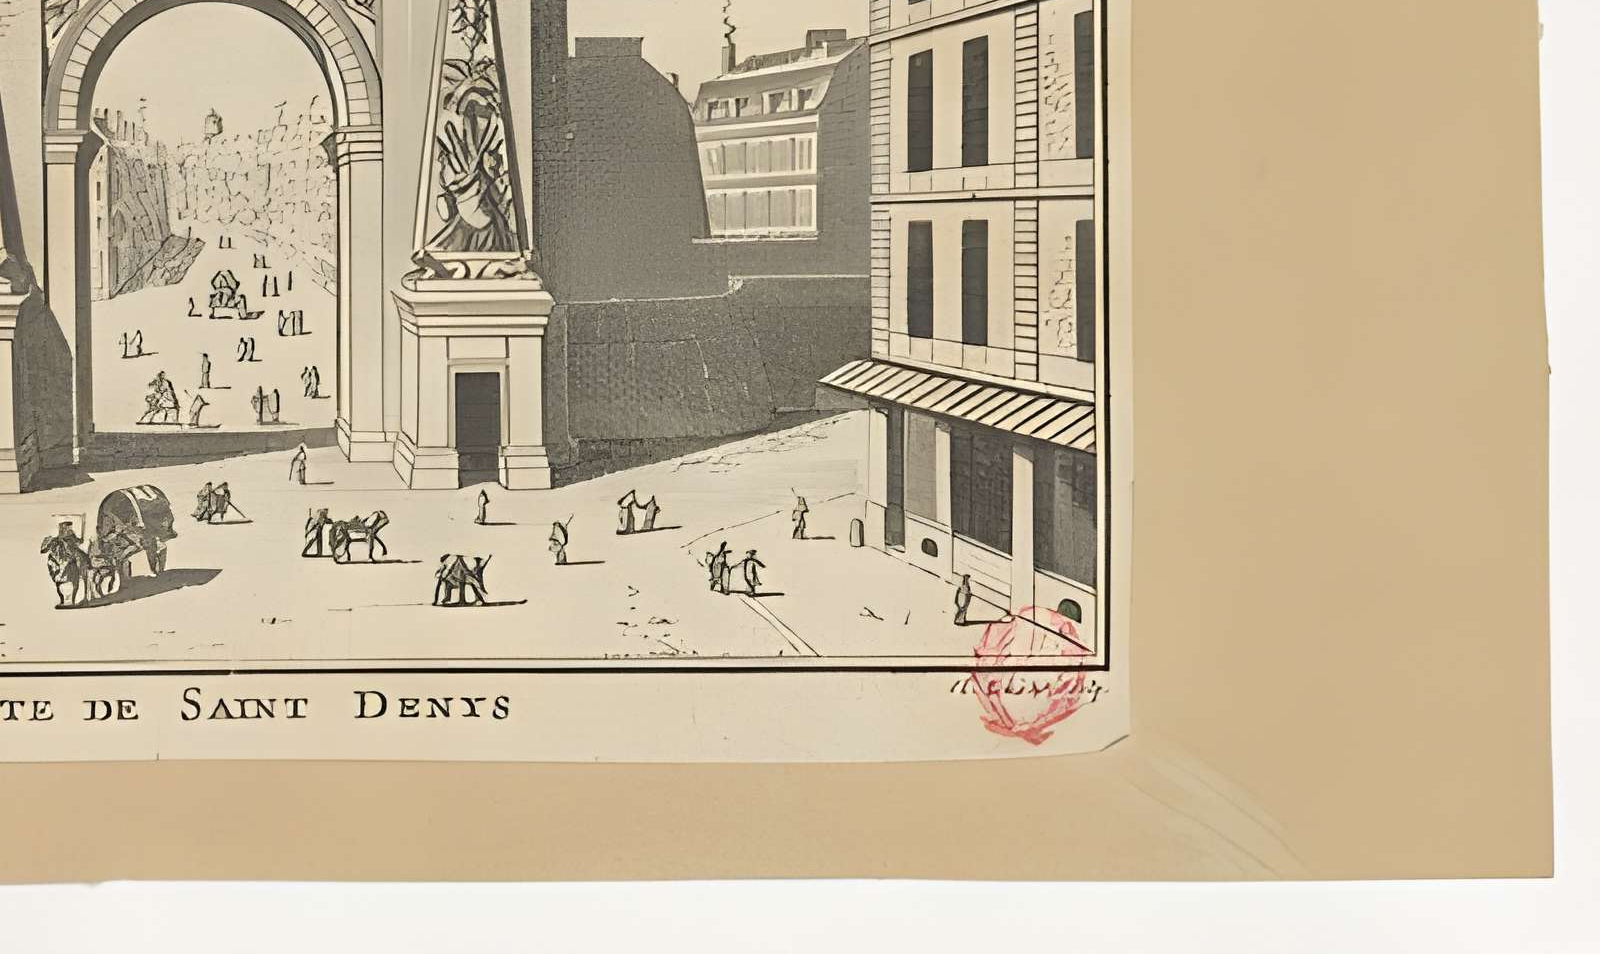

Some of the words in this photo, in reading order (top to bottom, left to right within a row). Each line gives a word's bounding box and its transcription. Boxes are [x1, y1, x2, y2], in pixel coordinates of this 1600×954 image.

[82, 699, 139, 722] DE
[180, 686, 309, 722] SAINT
[352, 690, 511, 722] DENYS
